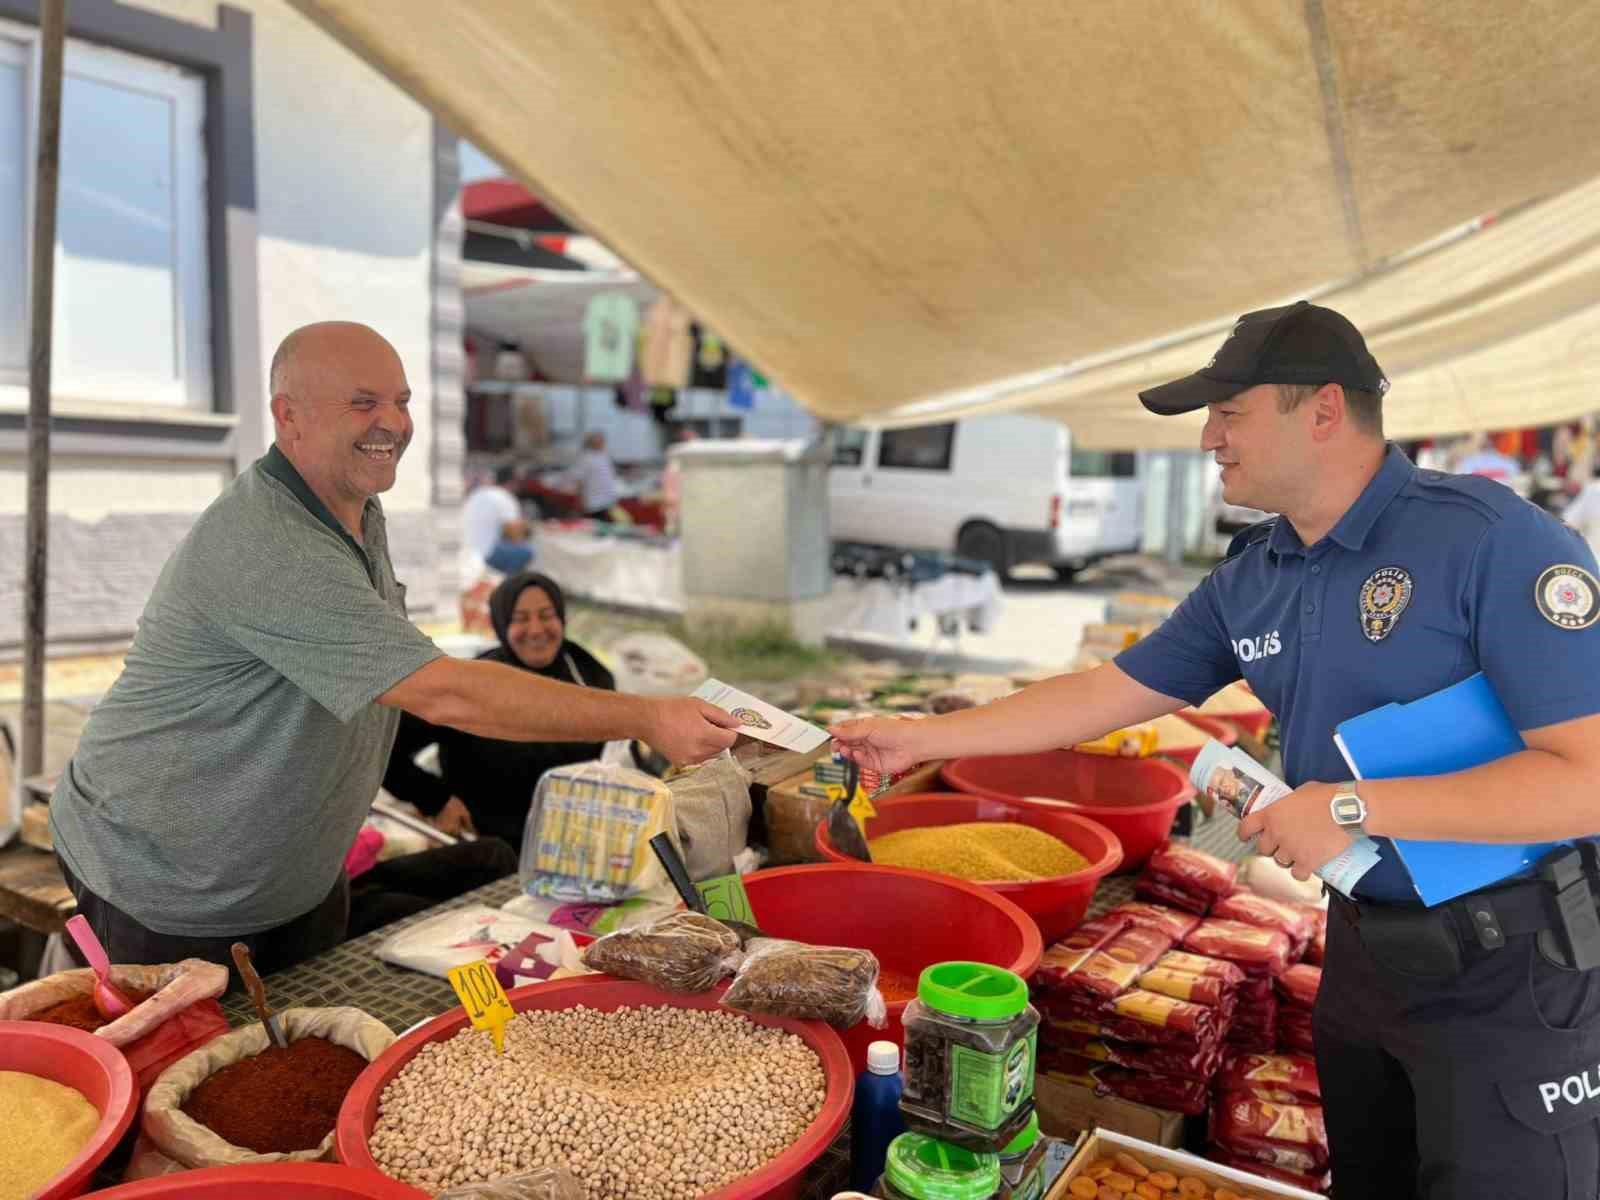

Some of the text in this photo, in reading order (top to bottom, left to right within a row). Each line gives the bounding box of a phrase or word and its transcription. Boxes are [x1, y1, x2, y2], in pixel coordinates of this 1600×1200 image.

[702, 879, 746, 921] 50
[458, 964, 498, 1018] 100
[1538, 1063, 1600, 1113] POL
